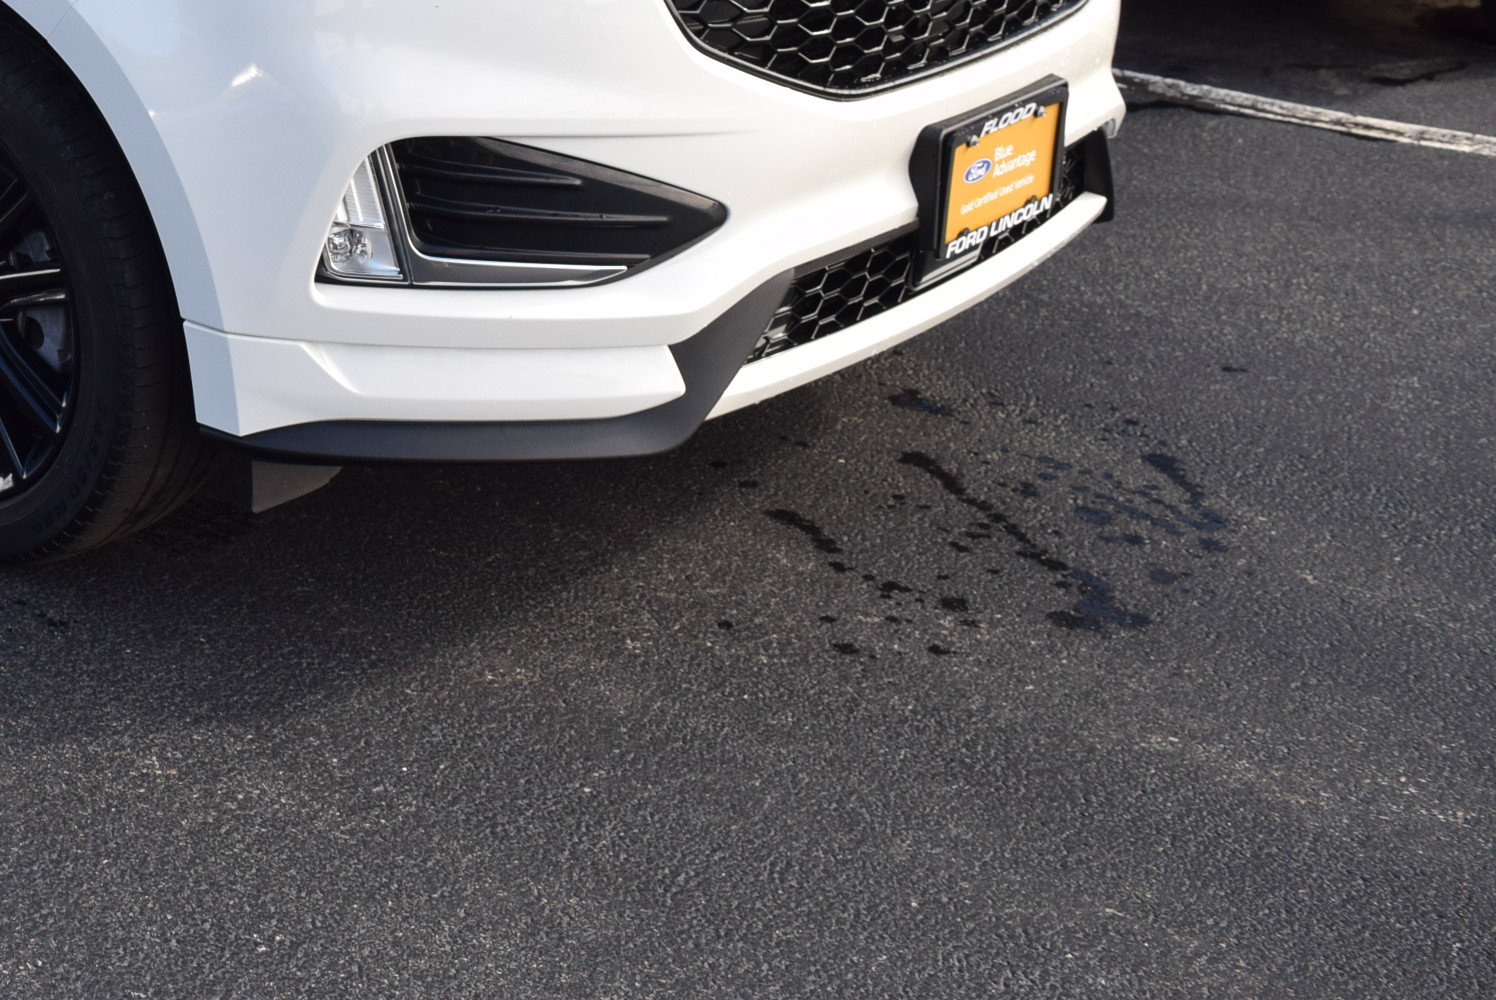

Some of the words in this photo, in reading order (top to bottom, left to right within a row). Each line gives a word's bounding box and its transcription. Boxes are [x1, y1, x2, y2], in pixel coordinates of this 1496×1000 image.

[979, 102, 1038, 138] FLOOD
[992, 150, 1036, 178] Advantage
[993, 144, 1014, 162] Blue
[945, 225, 988, 258] FORD
[989, 193, 1053, 238] LINCOLN
